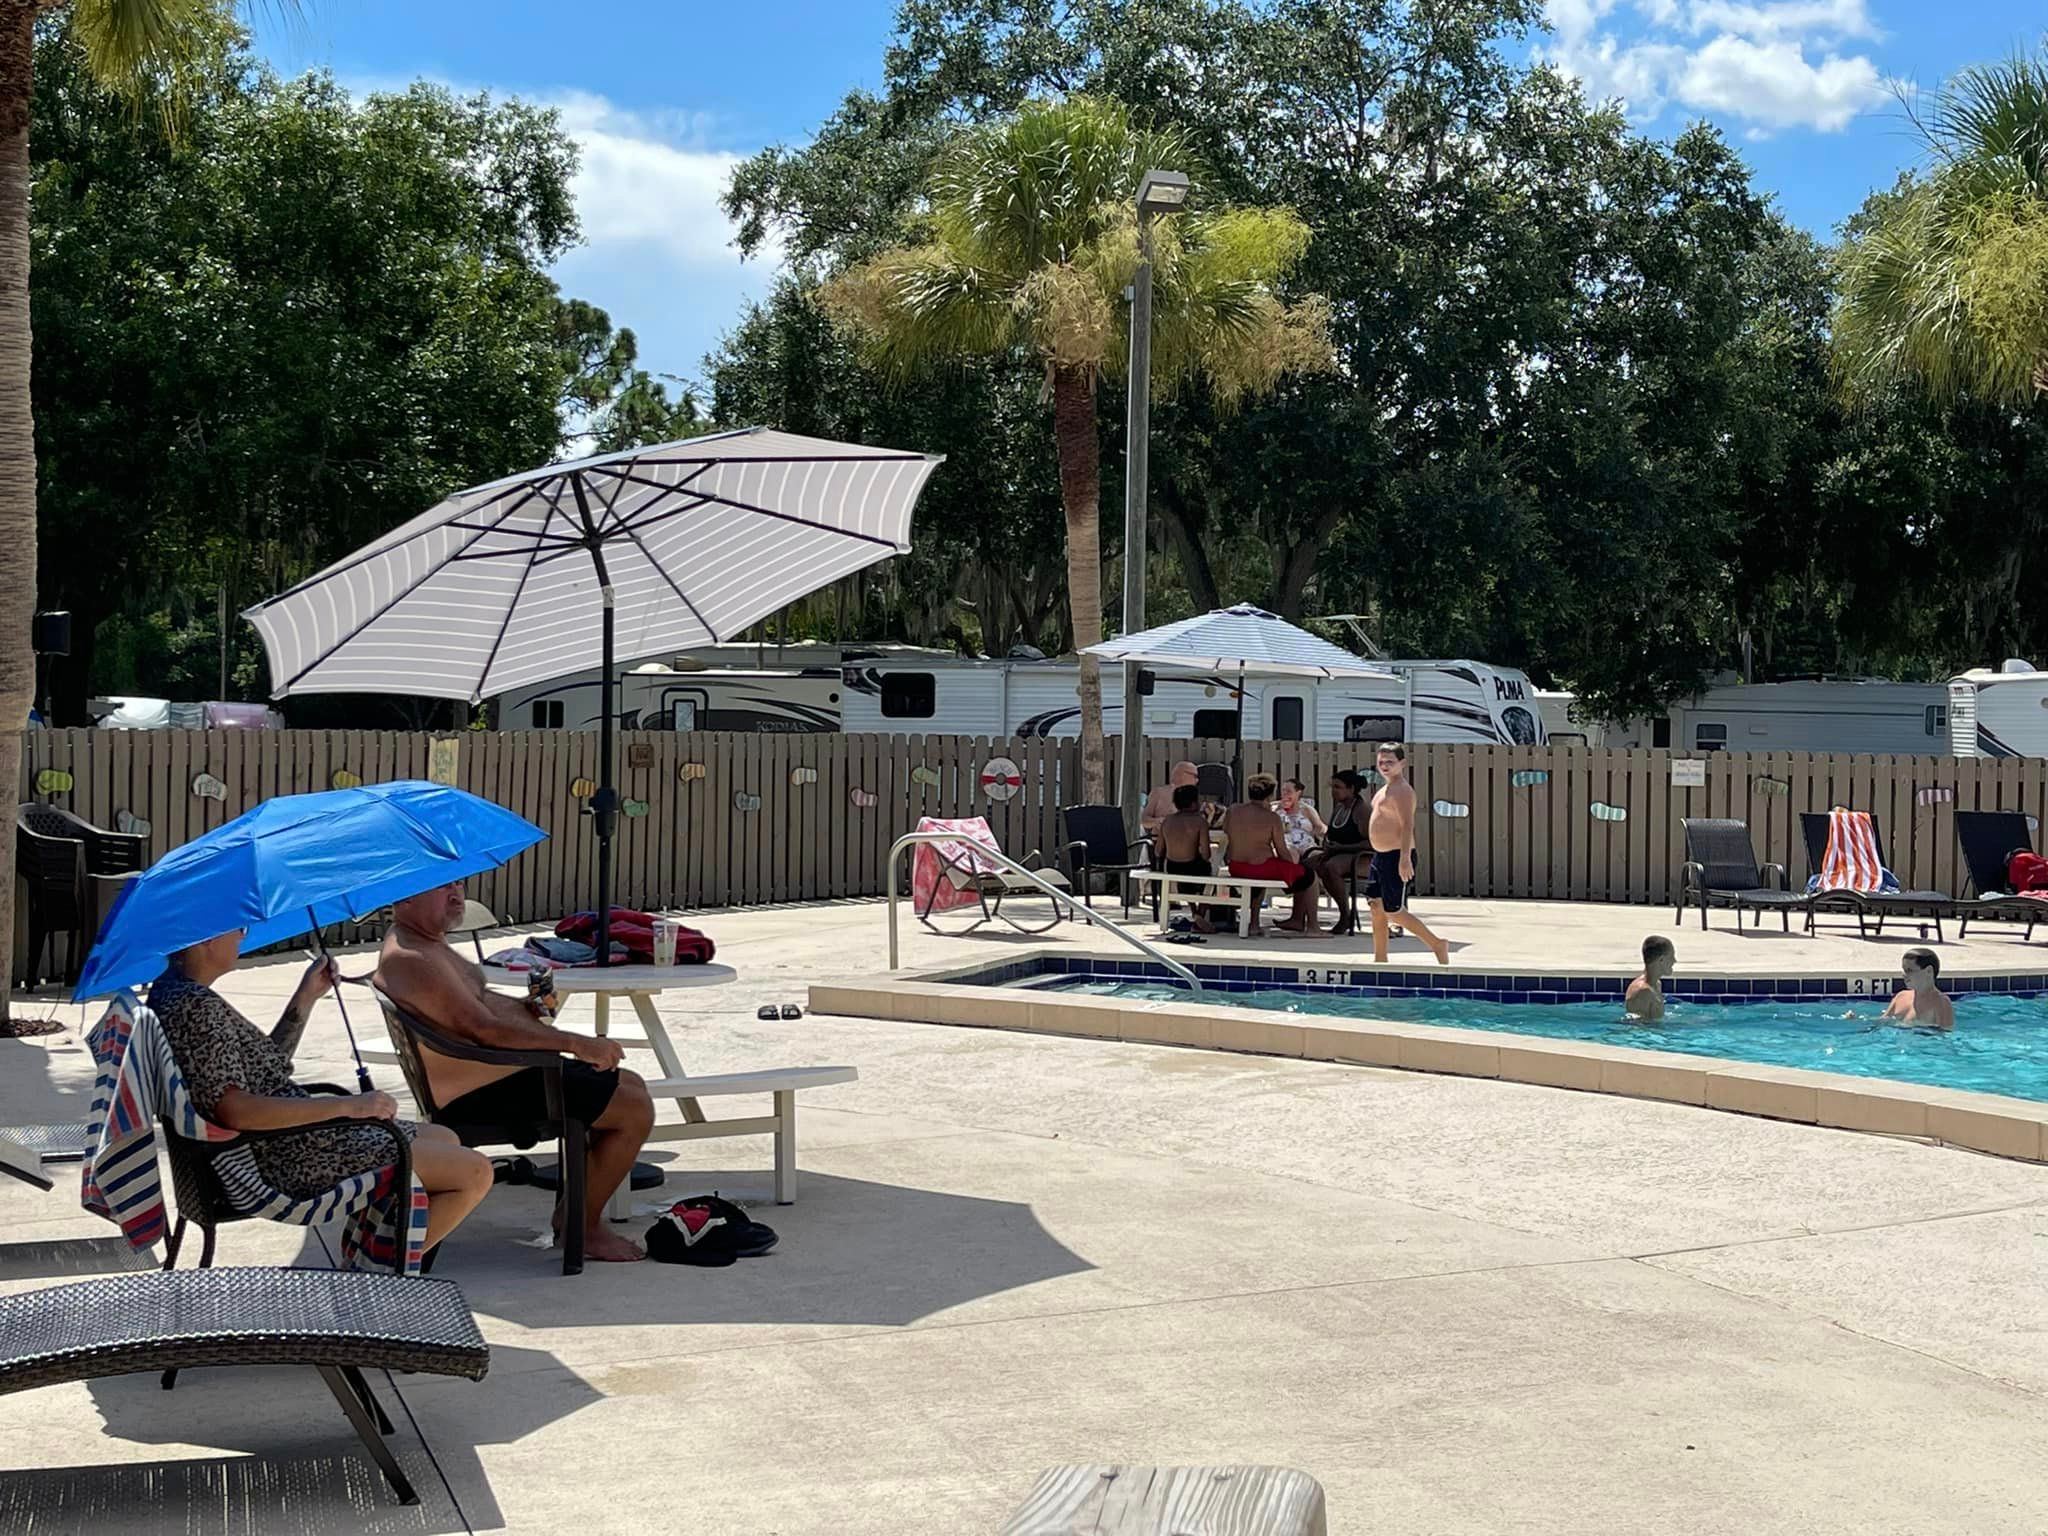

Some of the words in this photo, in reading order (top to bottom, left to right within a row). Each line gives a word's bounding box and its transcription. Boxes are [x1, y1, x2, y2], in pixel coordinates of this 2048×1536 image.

[1493, 676, 1525, 701] PUMA
[1306, 969, 1317, 984] 3
[1326, 970, 1348, 985] FT
[1854, 978, 1864, 994] 3
[1871, 978, 1890, 995] FT
